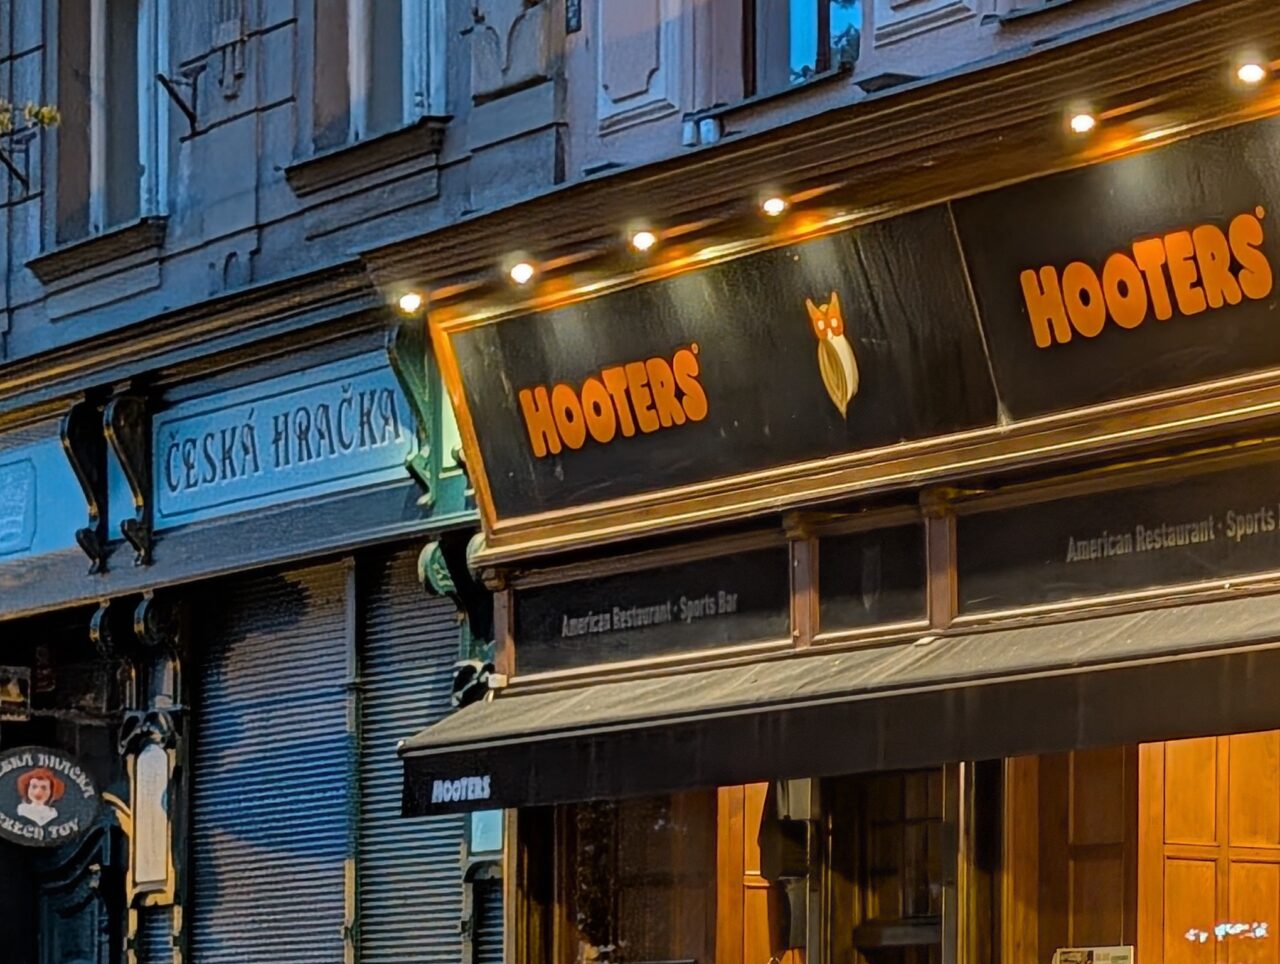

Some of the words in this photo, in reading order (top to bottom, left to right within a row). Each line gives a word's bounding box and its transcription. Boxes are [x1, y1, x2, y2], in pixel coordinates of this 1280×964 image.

[1020, 211, 1273, 348] HOOTERS
[164, 407, 261, 493] ČESKÁ
[271, 383, 403, 469] HRAČKA
[519, 347, 708, 458] HOOTERS
[1066, 536, 1132, 563] American
[1136, 515, 1216, 552] Restaurant
[1226, 508, 1275, 542] Sports
[562, 612, 612, 638] American
[613, 602, 672, 630] Restaurant
[680, 596, 717, 624] Sports
[718, 591, 739, 613] Bar
[431, 775, 491, 803] HOOTERS
